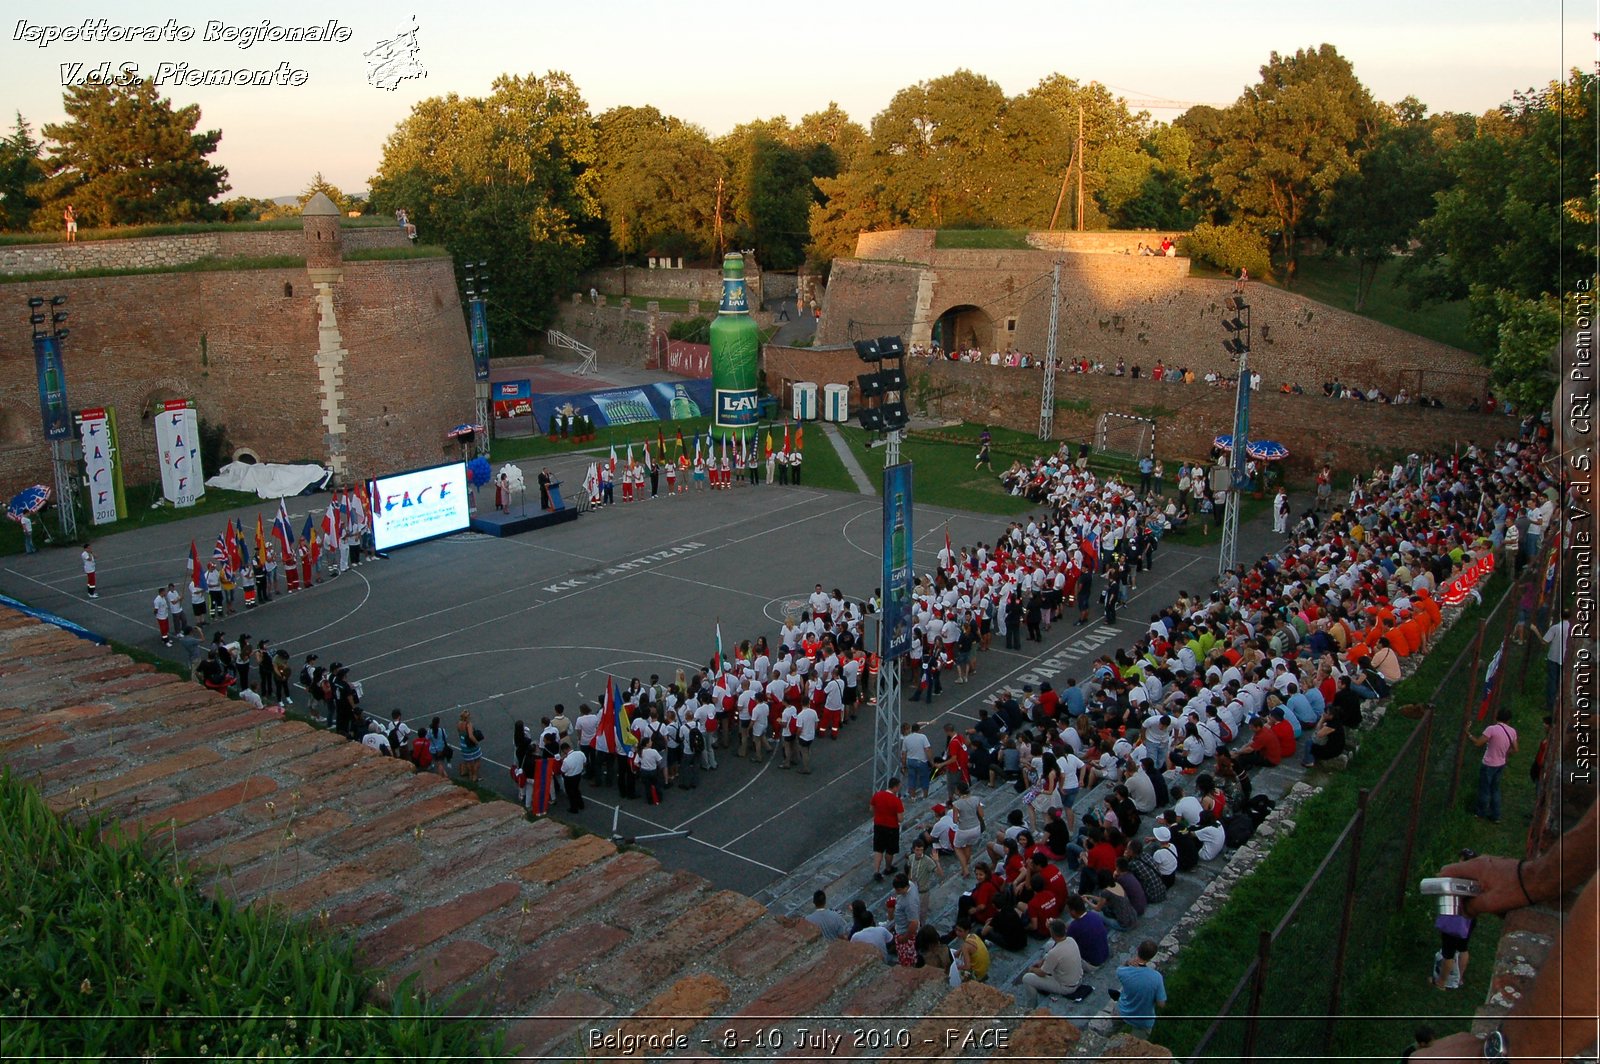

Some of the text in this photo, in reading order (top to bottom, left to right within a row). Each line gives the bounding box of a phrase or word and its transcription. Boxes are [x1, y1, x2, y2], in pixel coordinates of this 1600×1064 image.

[723, 396, 759, 411] LAV
[176, 494, 195, 505] 2010
[96, 509, 115, 521] 2010
[889, 634, 908, 650] LAV
[1015, 625, 1124, 686] PARTIZAN
